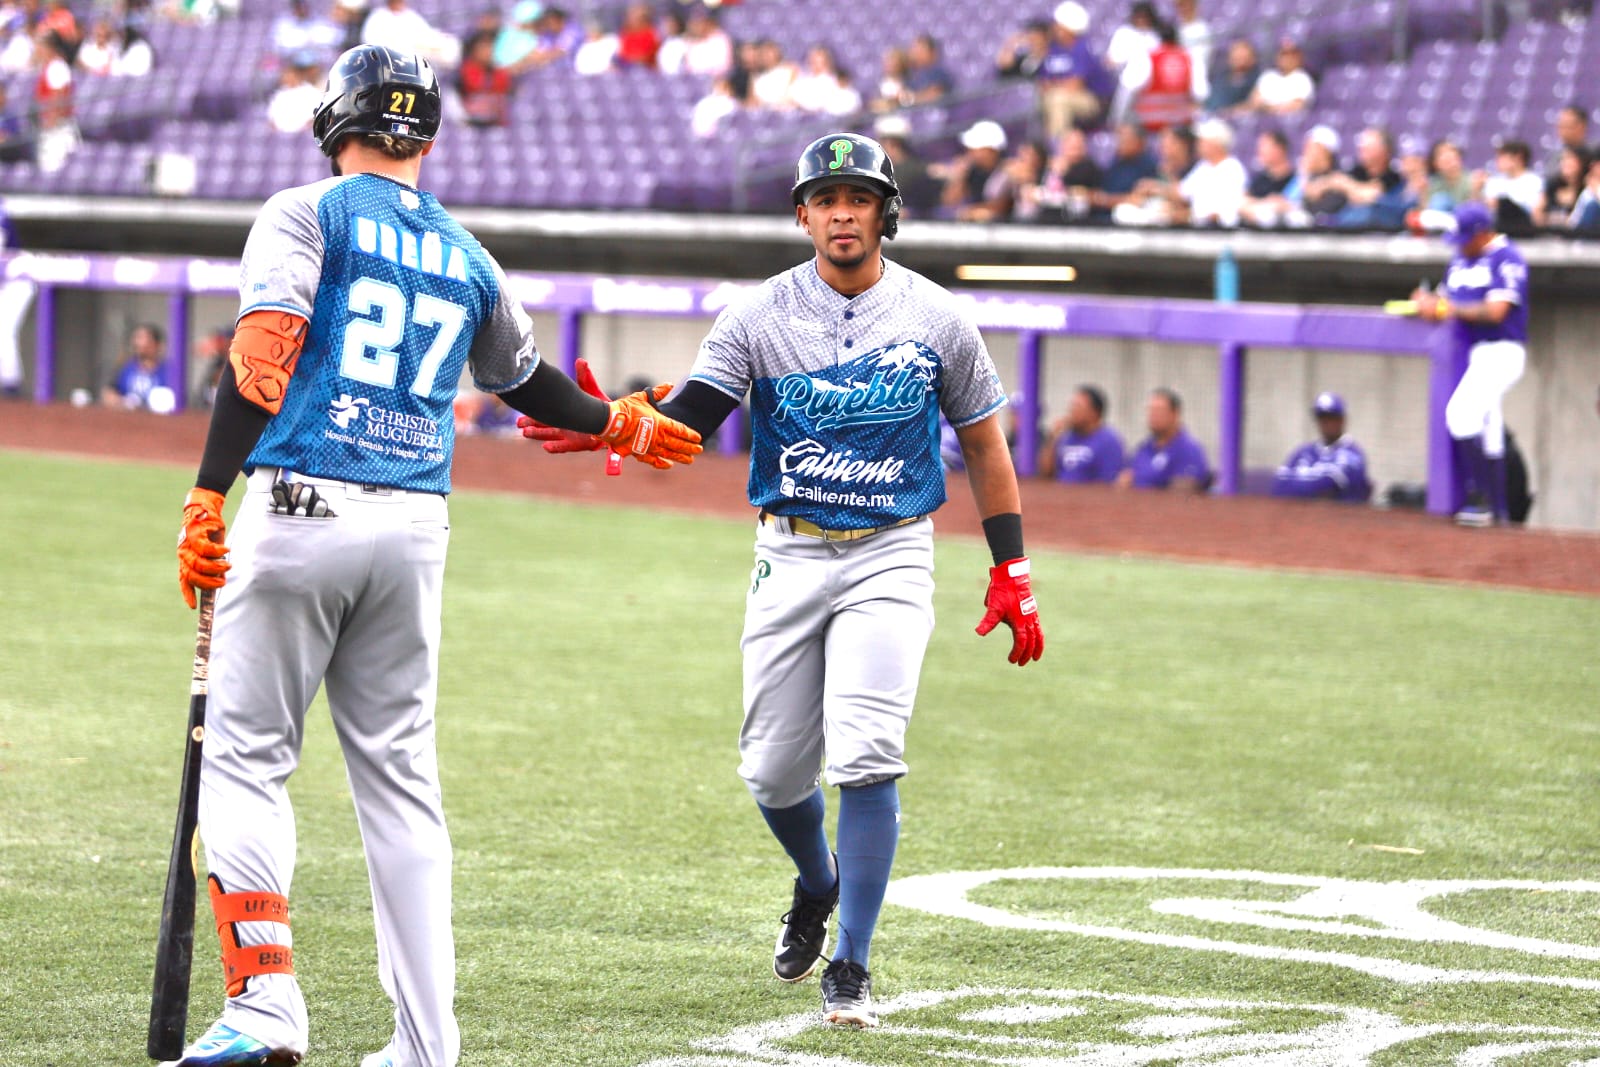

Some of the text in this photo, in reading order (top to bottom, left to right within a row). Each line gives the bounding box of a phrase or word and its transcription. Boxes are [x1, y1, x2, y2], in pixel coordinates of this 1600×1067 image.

[389, 91, 416, 114] 27
[828, 139, 853, 170] P
[340, 276, 468, 398] 27
[771, 369, 927, 432] Puebla
[367, 406, 438, 434] CHRISTUS
[325, 429, 356, 444] Hospital
[365, 421, 443, 449] MUGUERZA
[752, 559, 772, 595] P
